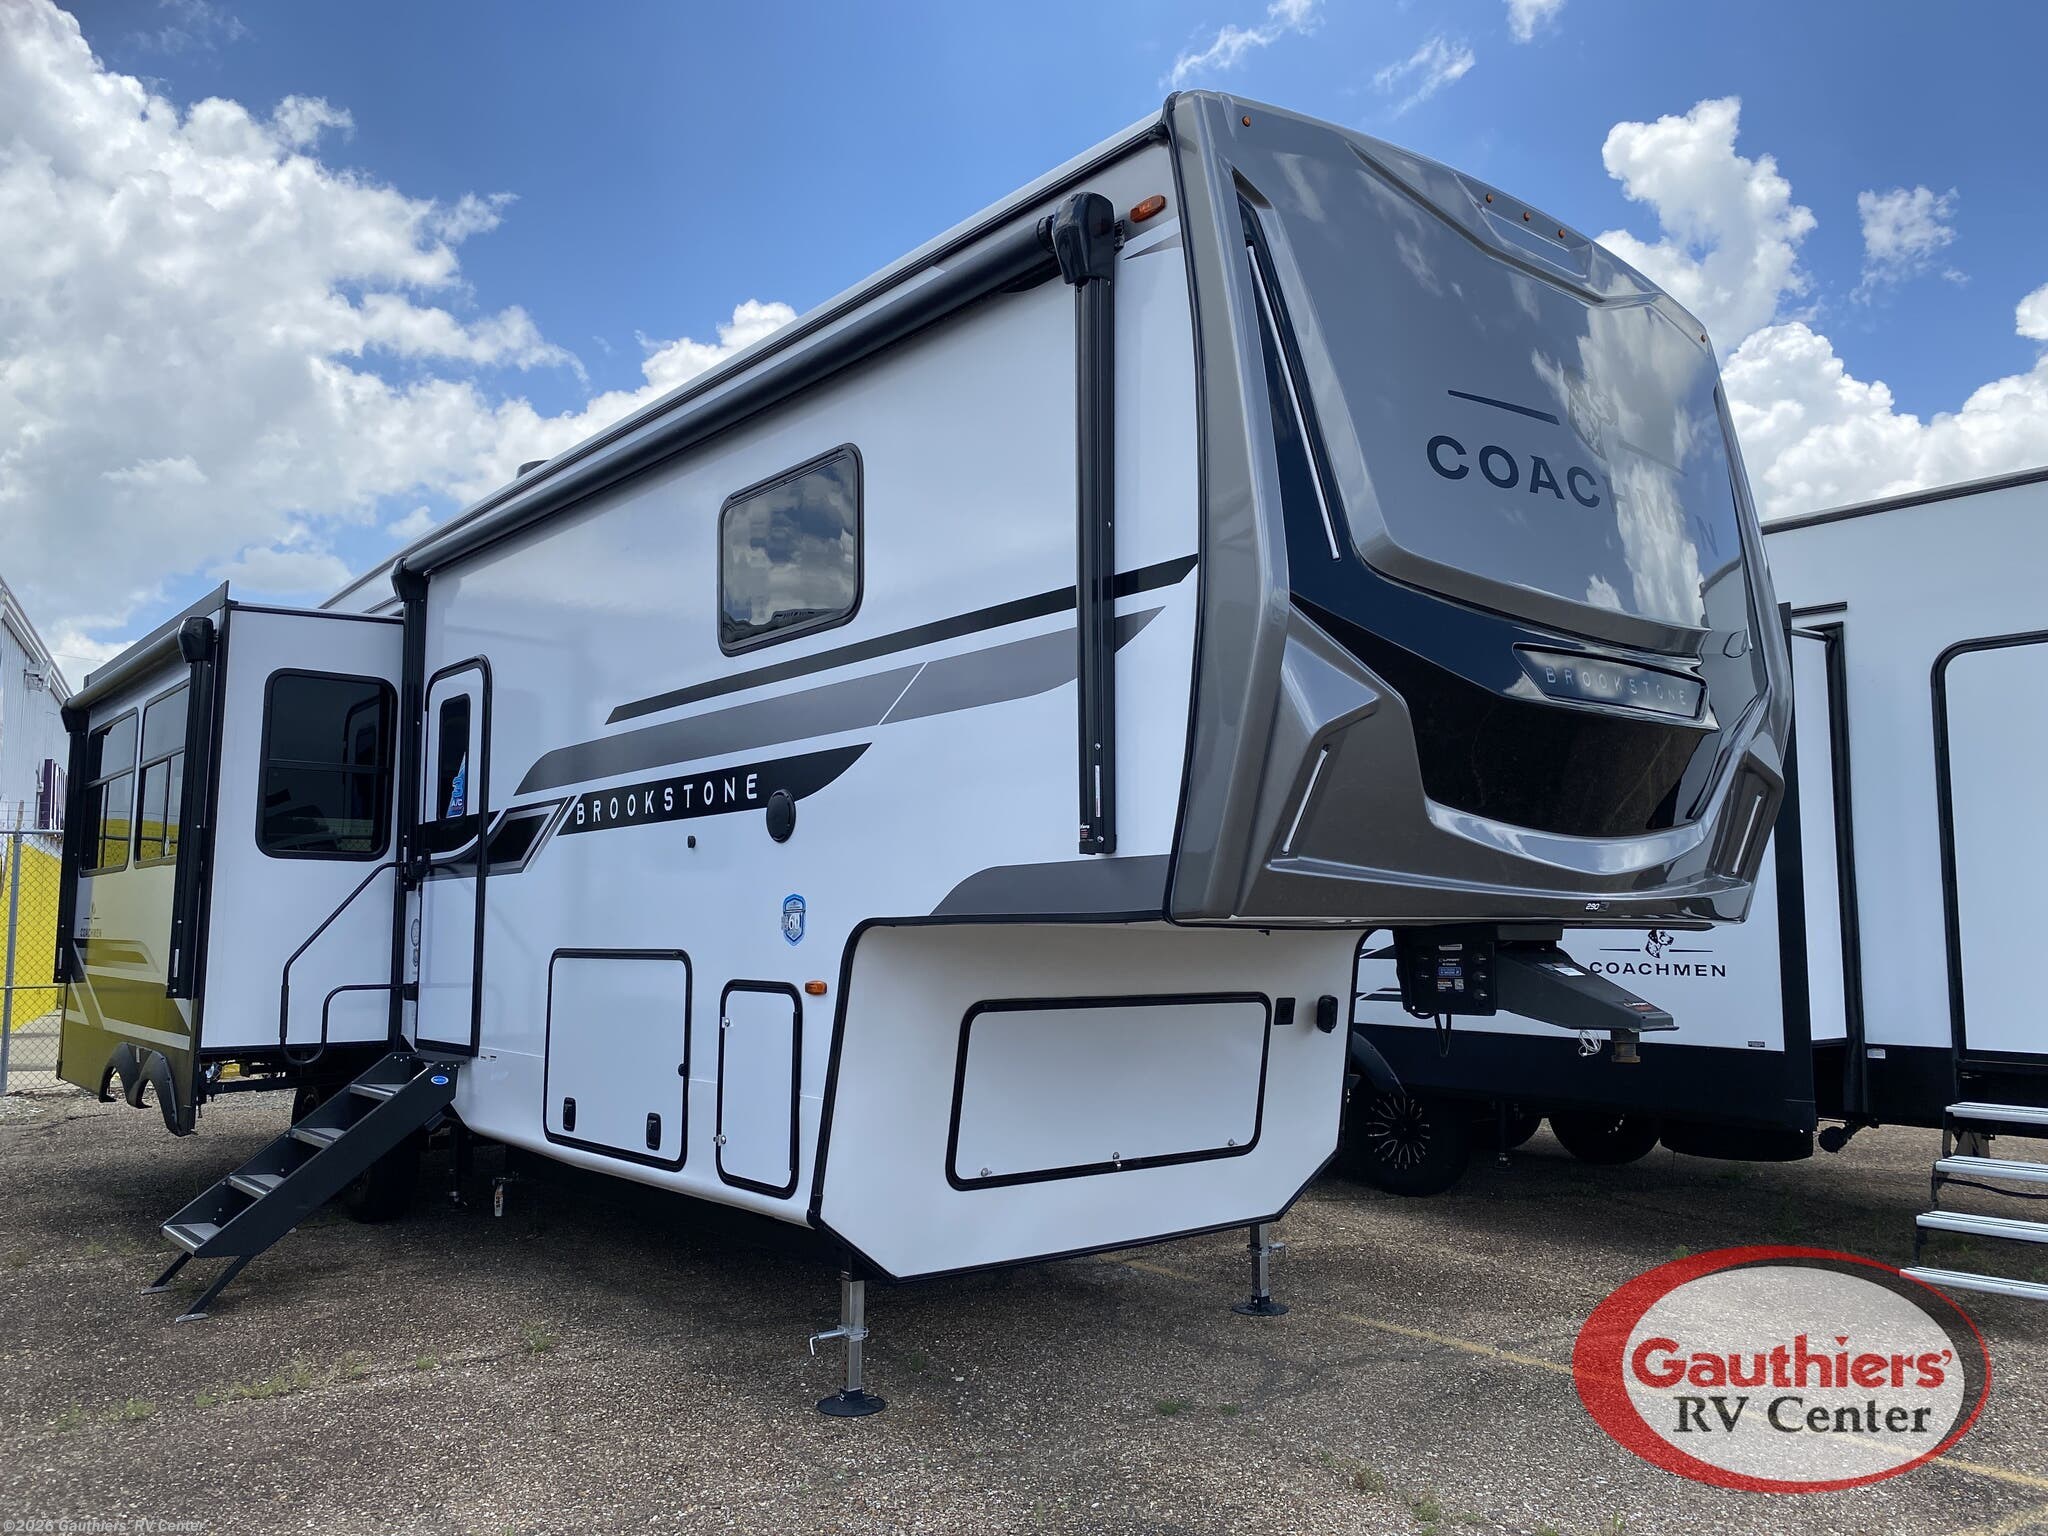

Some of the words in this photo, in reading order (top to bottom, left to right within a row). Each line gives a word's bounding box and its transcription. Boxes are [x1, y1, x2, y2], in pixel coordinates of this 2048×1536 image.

[1426, 434, 1719, 557] COACHMN
[1545, 667, 1688, 705] BROOKSTONE
[576, 772, 759, 825] BROOKSTONE
[1589, 961, 1728, 978] COACHMEN
